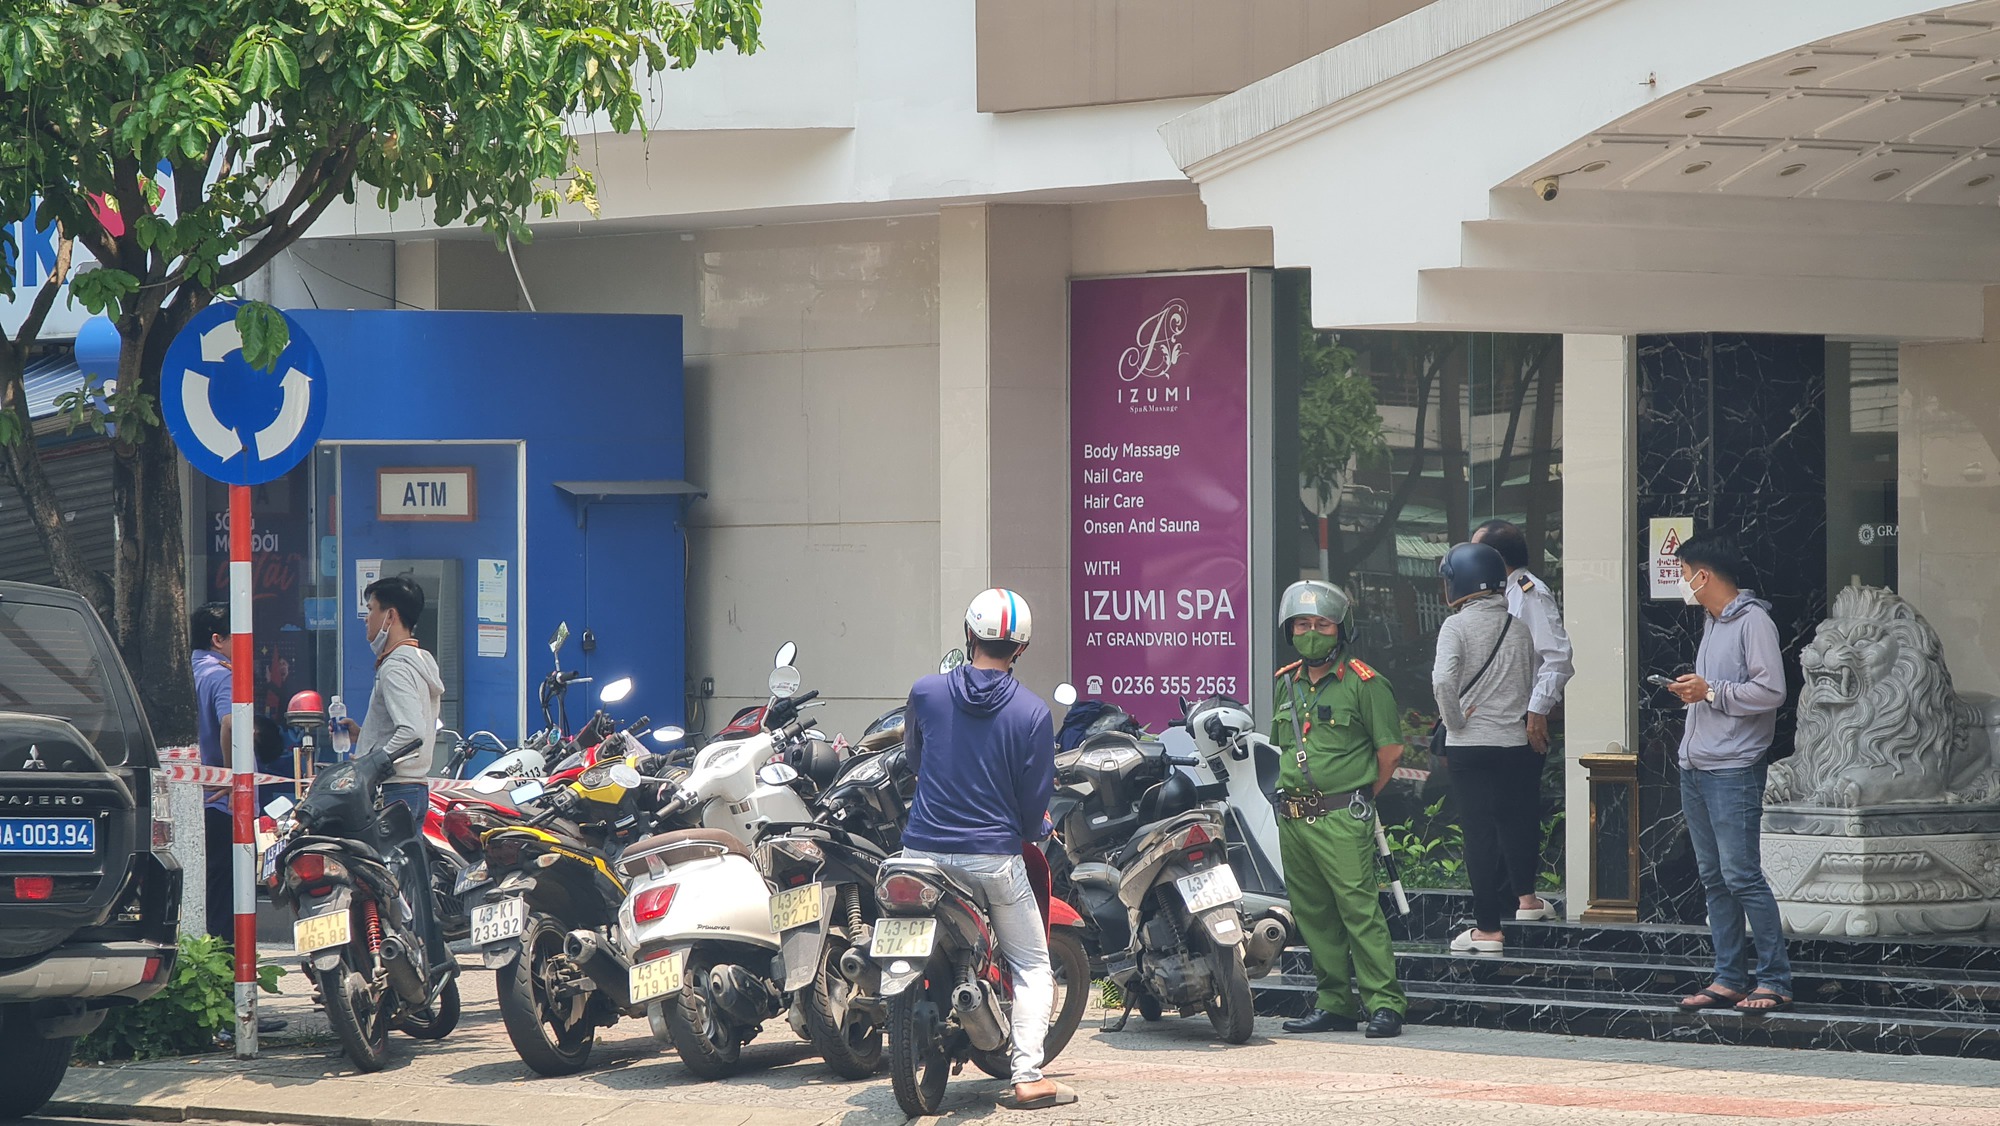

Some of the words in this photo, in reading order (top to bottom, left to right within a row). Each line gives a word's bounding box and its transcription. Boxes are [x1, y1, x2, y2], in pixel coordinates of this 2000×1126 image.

[1118, 386, 1190, 403] IZUMI
[1084, 444, 1118, 460] Body
[1123, 443, 1180, 459] Massage
[1084, 468, 1108, 484] Nail
[1112, 468, 1144, 483] Care
[402, 482, 447, 507] ATM
[1084, 494, 1109, 509] Hair
[1113, 493, 1144, 508] Care
[1083, 519, 1124, 534] Onsen
[1128, 518, 1155, 533] And
[1159, 518, 1200, 532] Sauna
[1084, 561, 1121, 576] WITH
[1660, 569, 1683, 578] 足下注
[1084, 590, 1165, 621] IZUMI
[1177, 589, 1235, 620] SPA
[1086, 632, 1102, 646] AT
[1106, 632, 1188, 646] GRANDVRIO
[1192, 632, 1236, 646] HOTEL
[1112, 676, 1155, 695] 0236
[1160, 676, 1191, 694] 355
[1196, 676, 1236, 694] 2563
[0, 824, 89, 846] A-003.94
[778, 886, 812, 910] 43-C1
[1192, 885, 1233, 909] 8559
[479, 902, 514, 924] 43-K1
[773, 903, 819, 930] 392.79
[474, 918, 519, 943] 233.92
[884, 921, 925, 936] 43-C1
[875, 938, 928, 954] 674.15
[638, 958, 673, 981] 43-C1
[633, 973, 680, 1000] 719.19
